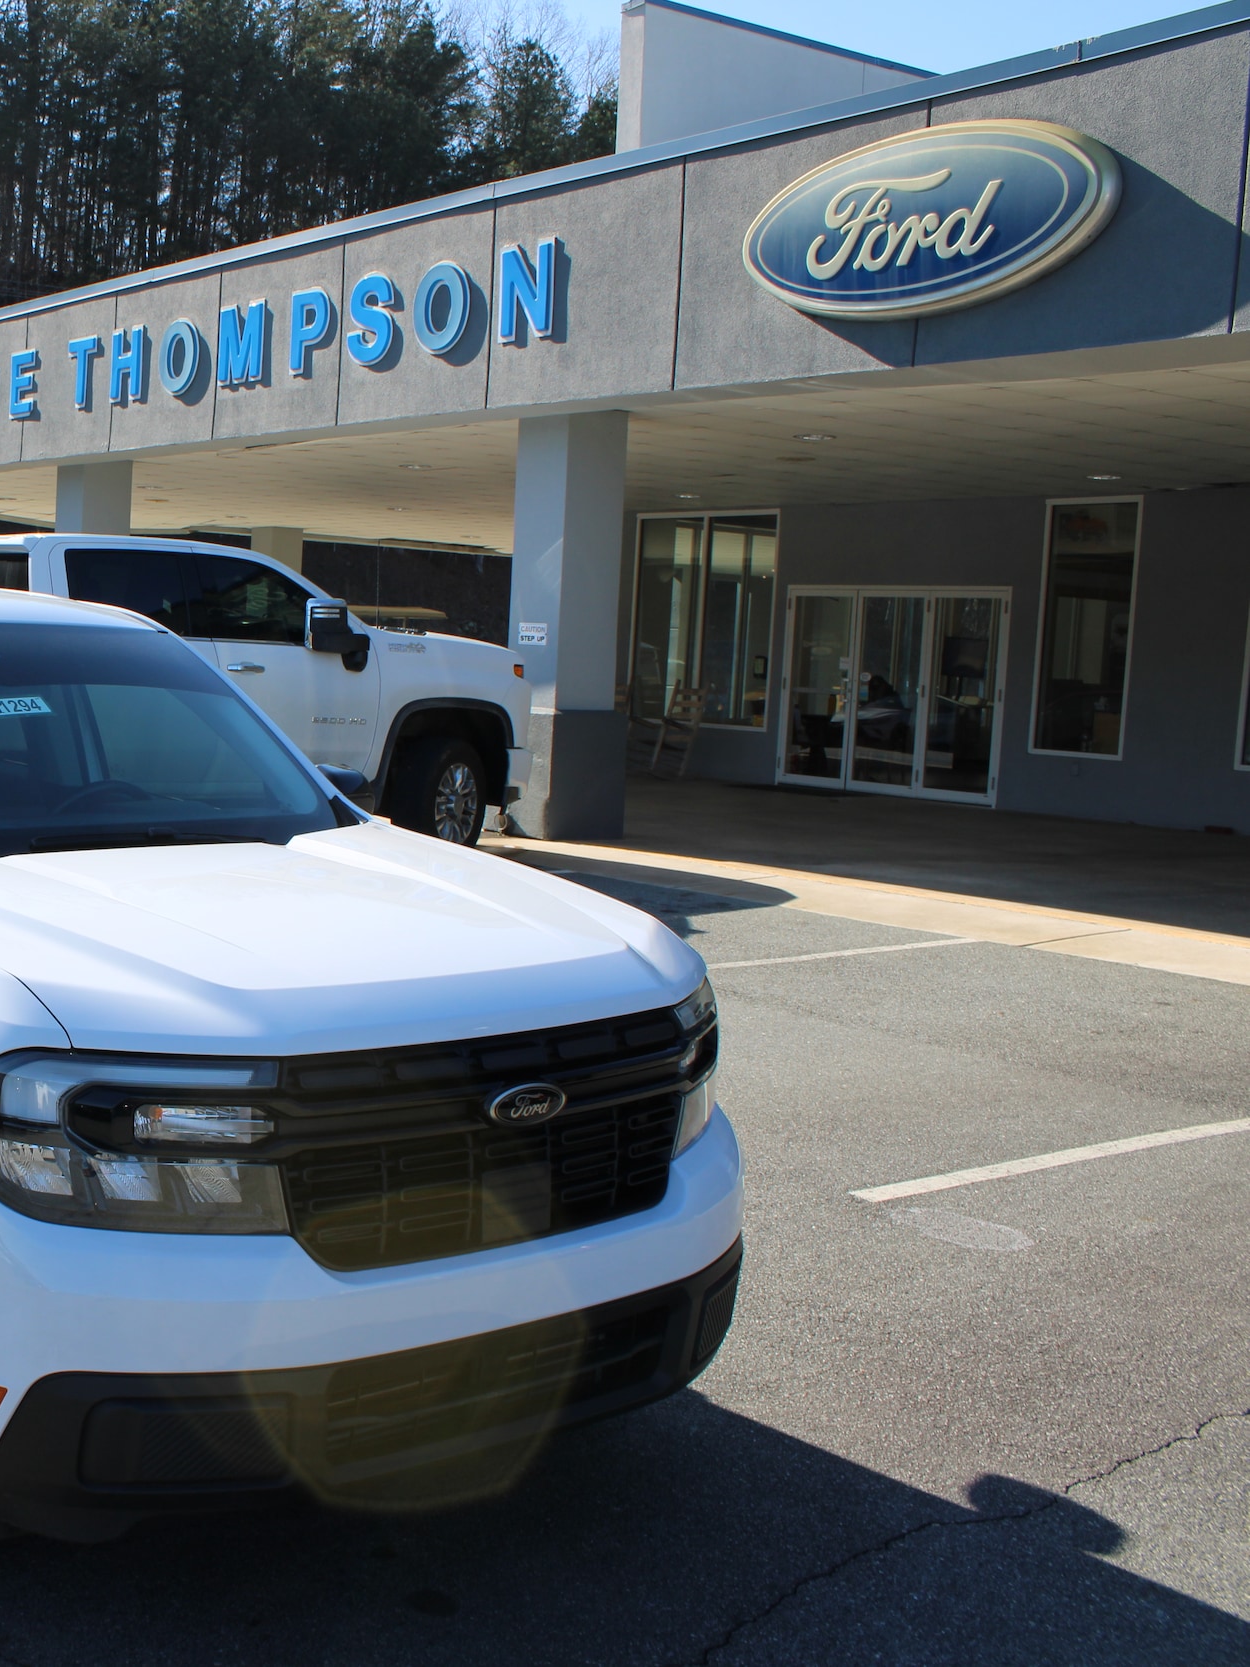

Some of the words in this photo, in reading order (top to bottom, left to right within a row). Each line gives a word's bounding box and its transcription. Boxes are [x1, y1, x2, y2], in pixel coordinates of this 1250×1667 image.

[806, 168, 1004, 280] Ford
[68, 237, 556, 410] THOMPSON
[511, 1093, 550, 1118] Ford
